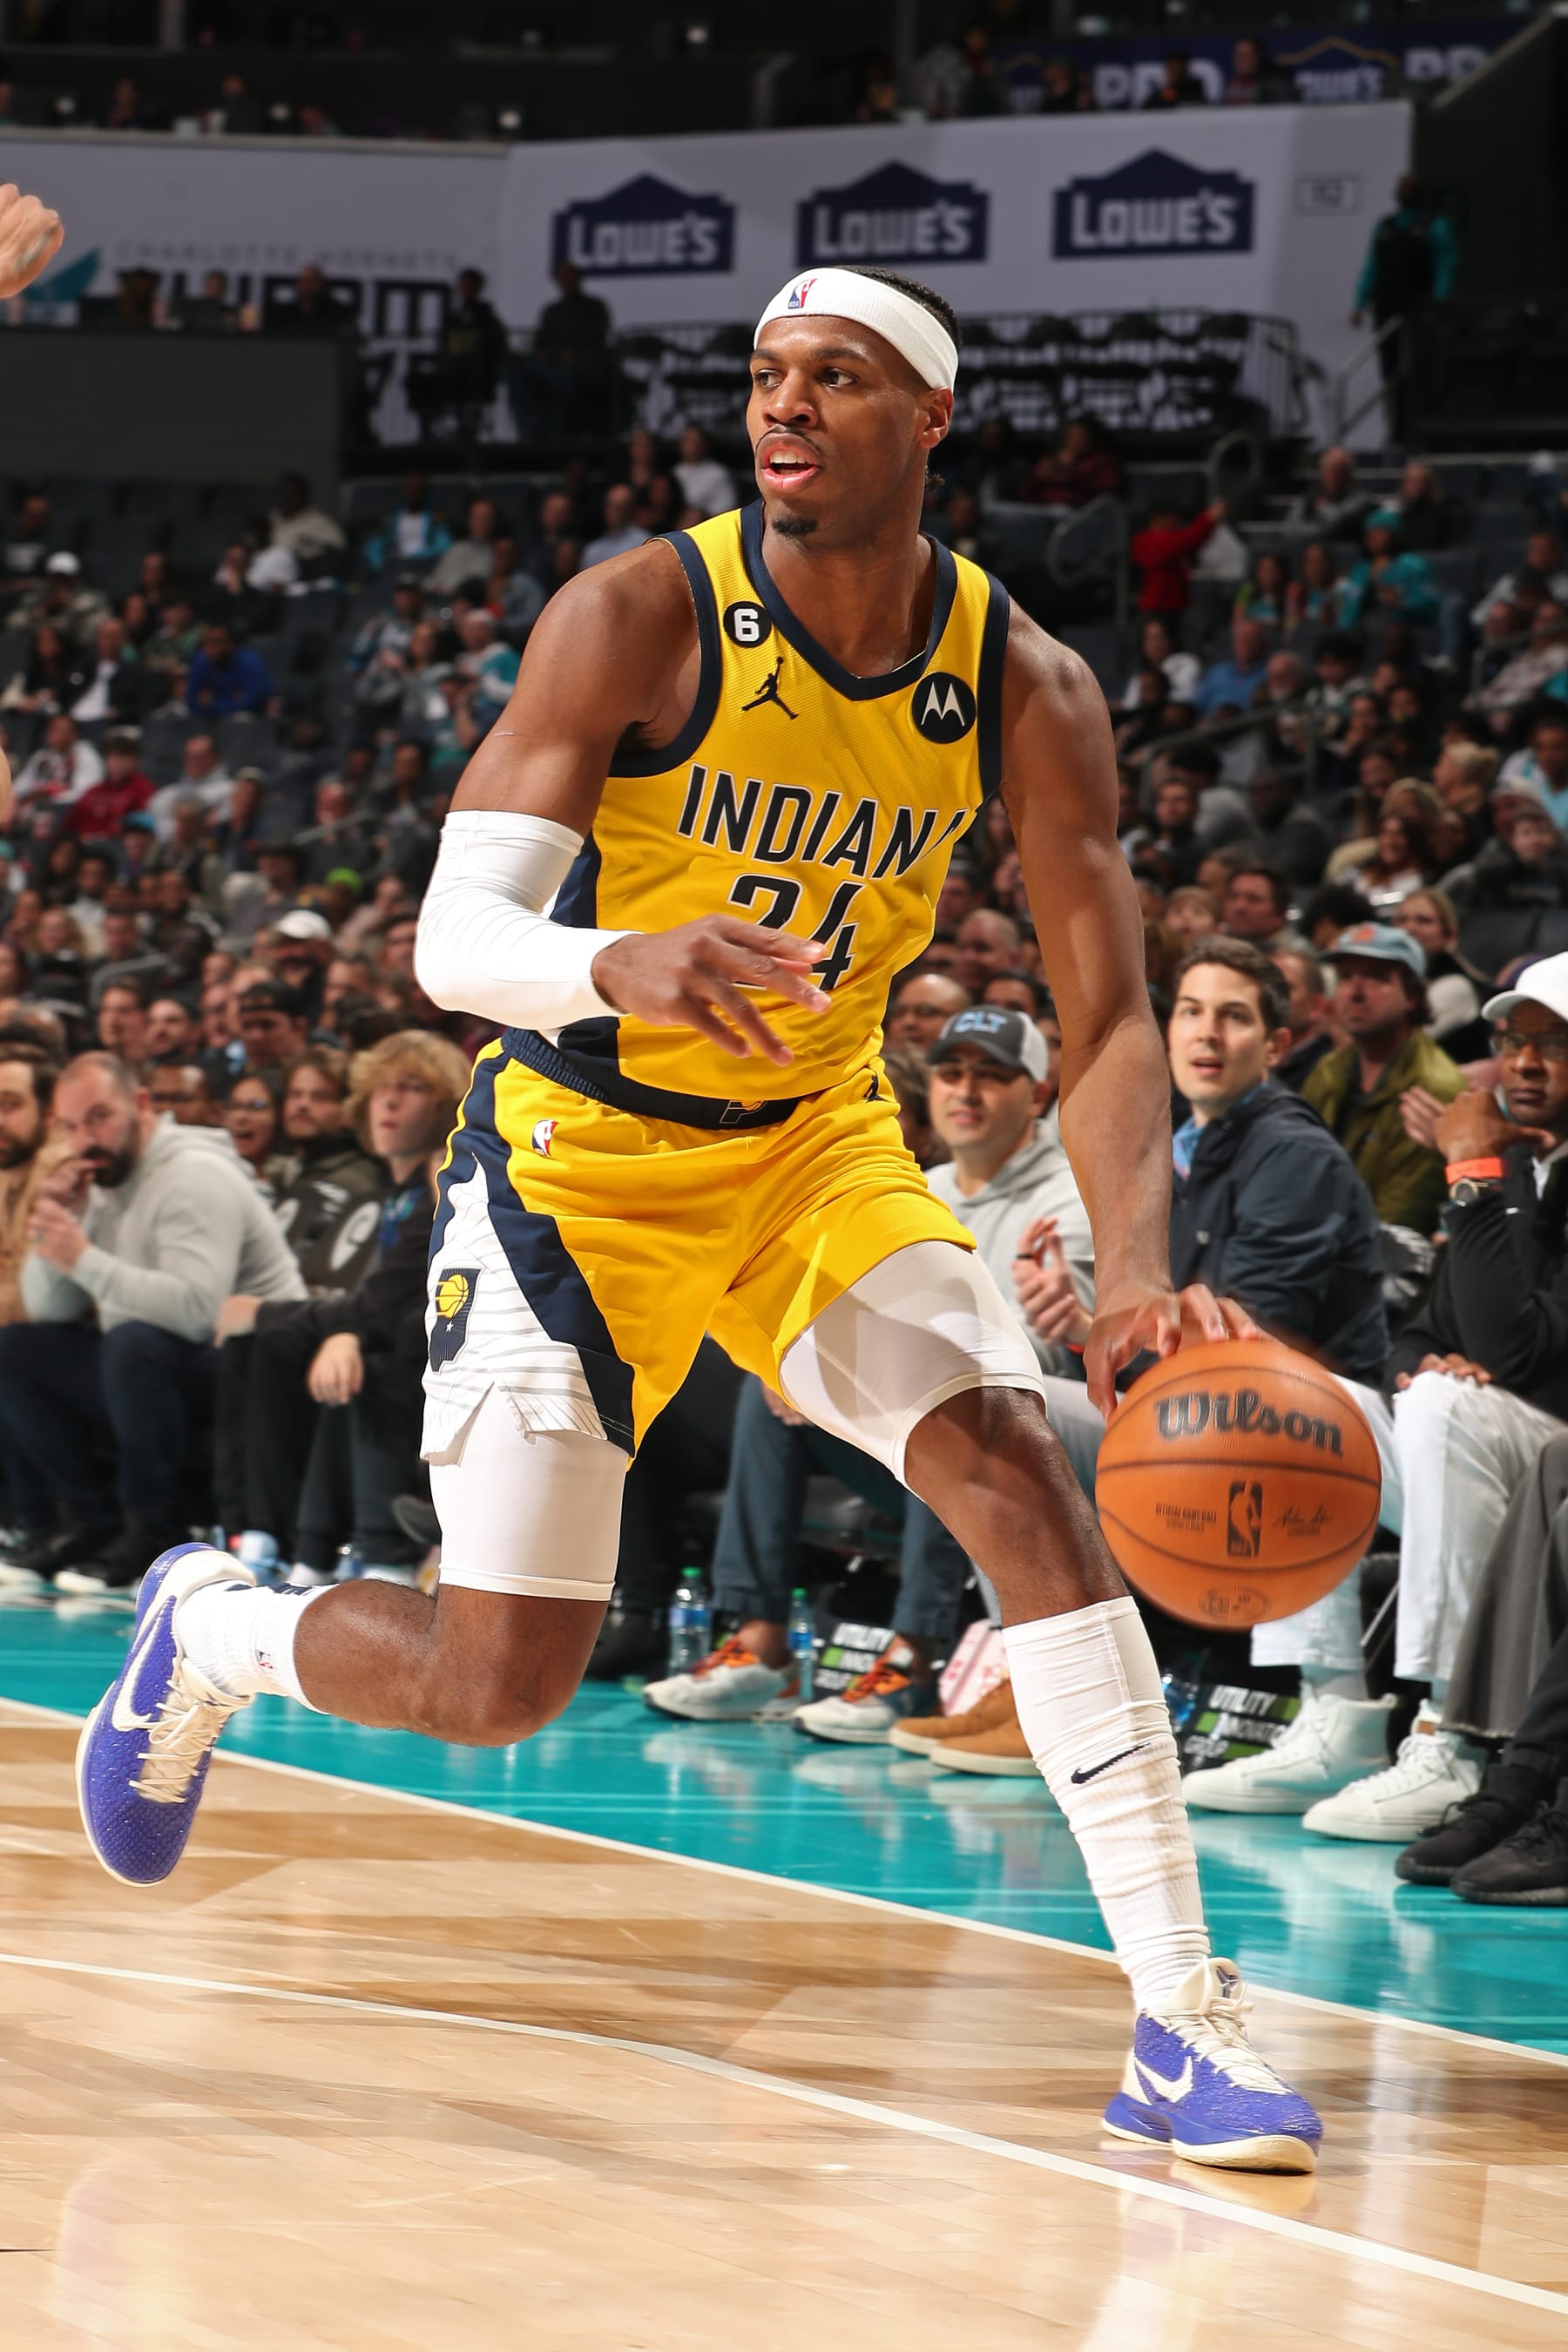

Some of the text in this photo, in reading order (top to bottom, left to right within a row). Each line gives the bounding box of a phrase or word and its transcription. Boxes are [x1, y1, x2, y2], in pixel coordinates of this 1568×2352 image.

[568, 212, 723, 267] LOWE'S
[814, 200, 972, 259] LOWE'S
[1071, 188, 1238, 249] LOWE'S
[733, 607, 760, 643] 6
[727, 873, 868, 991] 24
[954, 1010, 1008, 1034] CLT
[1154, 1389, 1343, 1460] Wilson
[832, 1623, 896, 1652] UTILITY
[1209, 1684, 1278, 1716] UTILITY
[1184, 1734, 1229, 1759] GROUP
